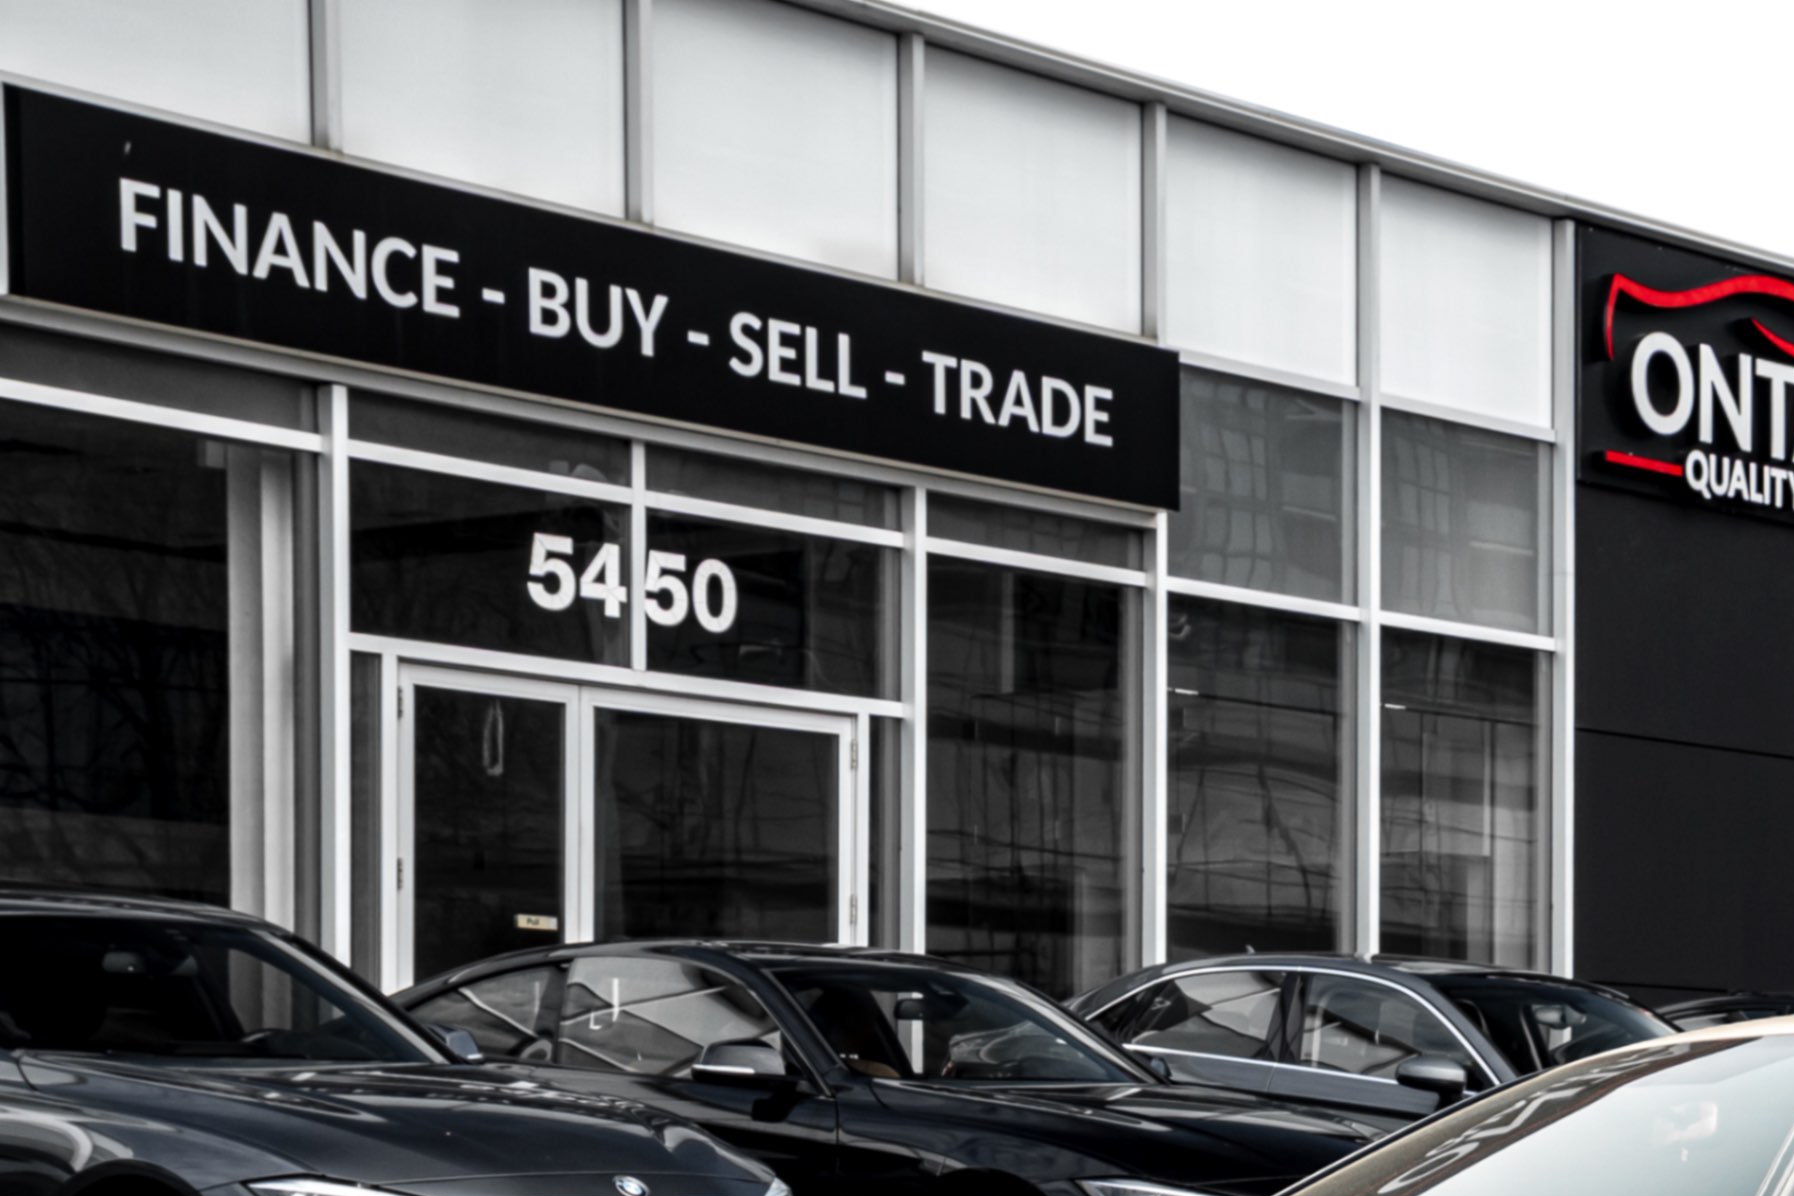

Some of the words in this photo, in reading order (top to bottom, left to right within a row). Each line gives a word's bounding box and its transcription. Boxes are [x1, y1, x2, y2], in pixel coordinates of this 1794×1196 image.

[118, 177, 461, 319] FINANCE
[528, 267, 668, 357] BUY
[729, 312, 867, 399] SELL
[921, 350, 1113, 447] TRADE
[526, 532, 738, 634] 5450
